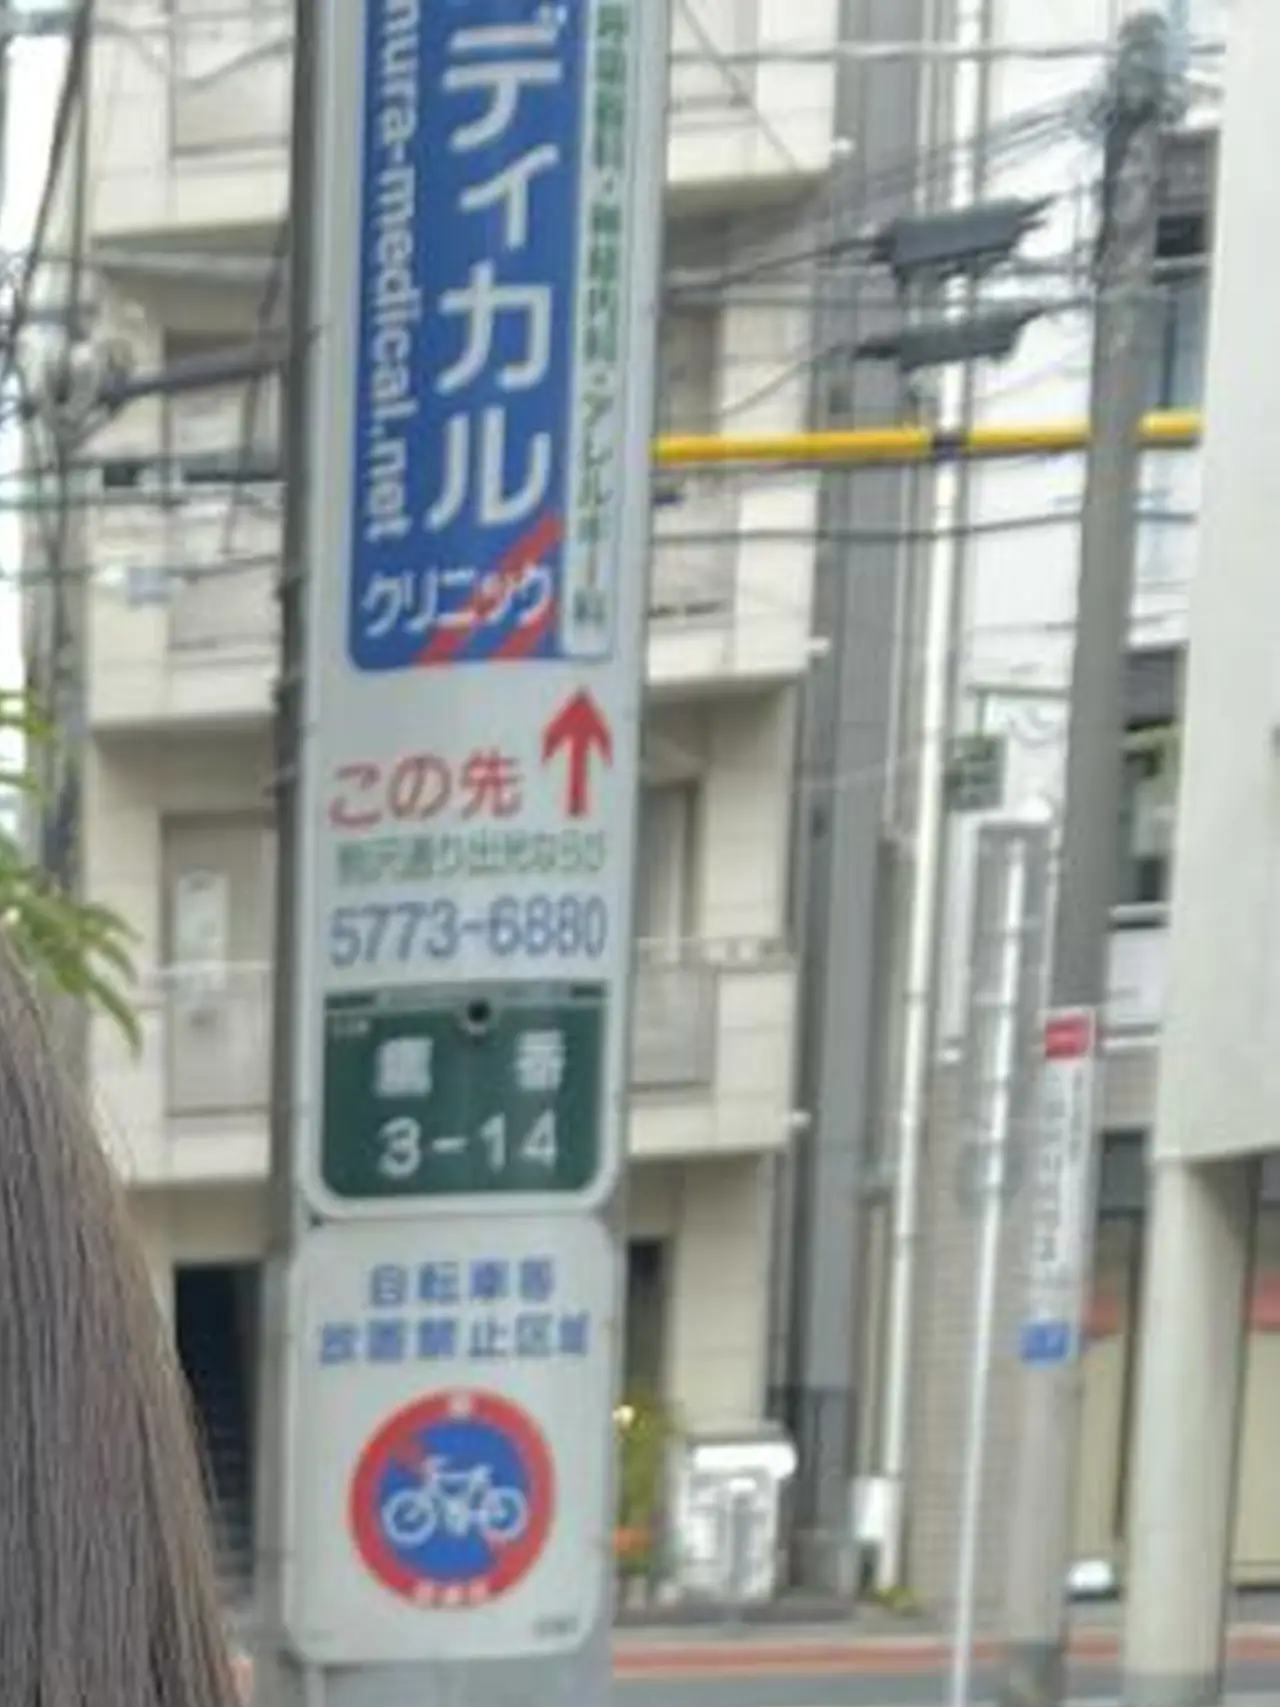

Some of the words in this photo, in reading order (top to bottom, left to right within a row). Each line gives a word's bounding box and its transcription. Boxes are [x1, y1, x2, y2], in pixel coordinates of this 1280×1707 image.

[361, 564, 552, 639] クリニック
[328, 748, 523, 829] この先
[375, 1107, 558, 1181] 3-14
